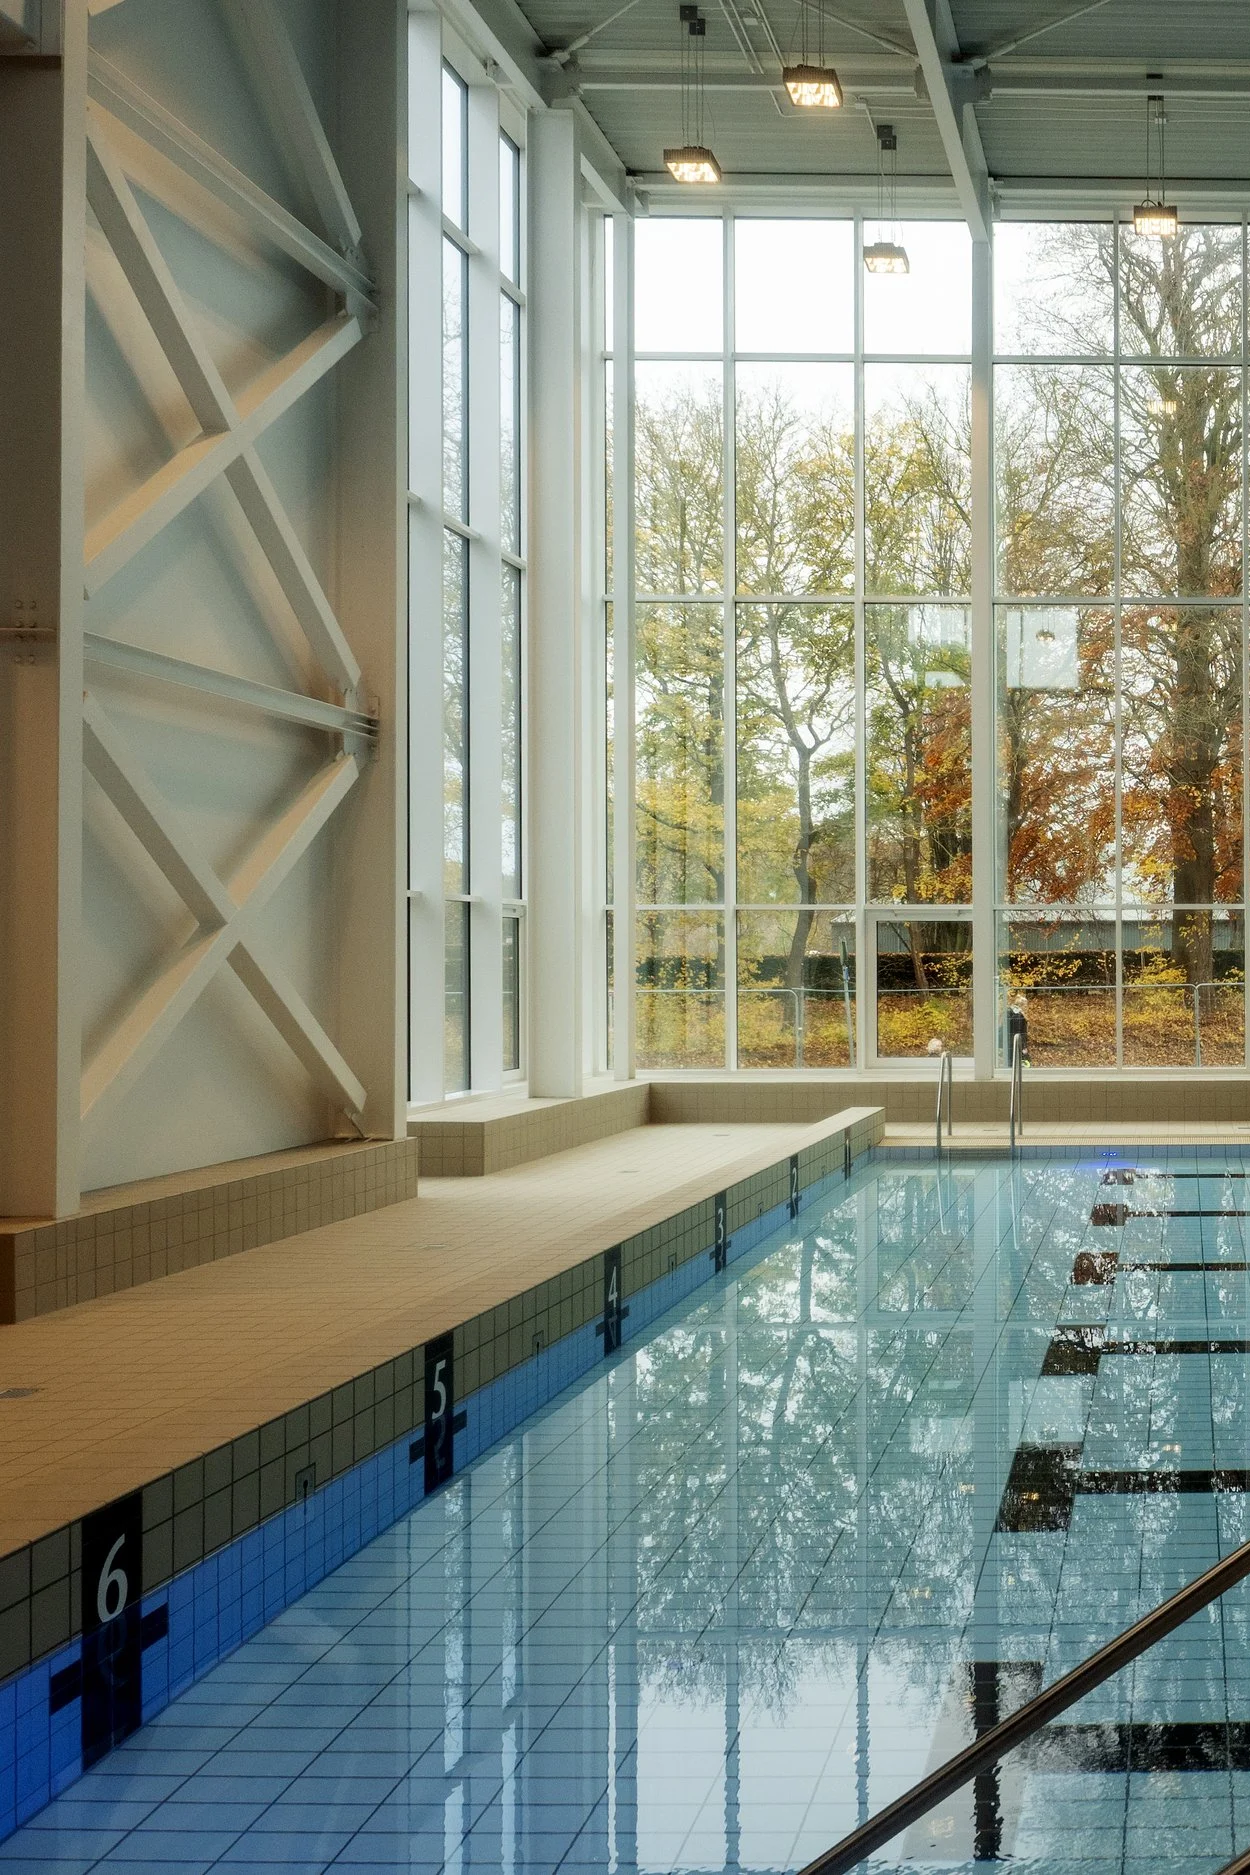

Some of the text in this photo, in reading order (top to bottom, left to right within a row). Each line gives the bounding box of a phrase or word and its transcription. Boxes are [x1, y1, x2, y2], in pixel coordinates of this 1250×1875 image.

[792, 1167, 798, 1198] 2
[717, 1207, 724, 1244] 3
[608, 1266, 618, 1308] 4
[431, 1359, 447, 1420] 5
[96, 1533, 129, 1624] 6
